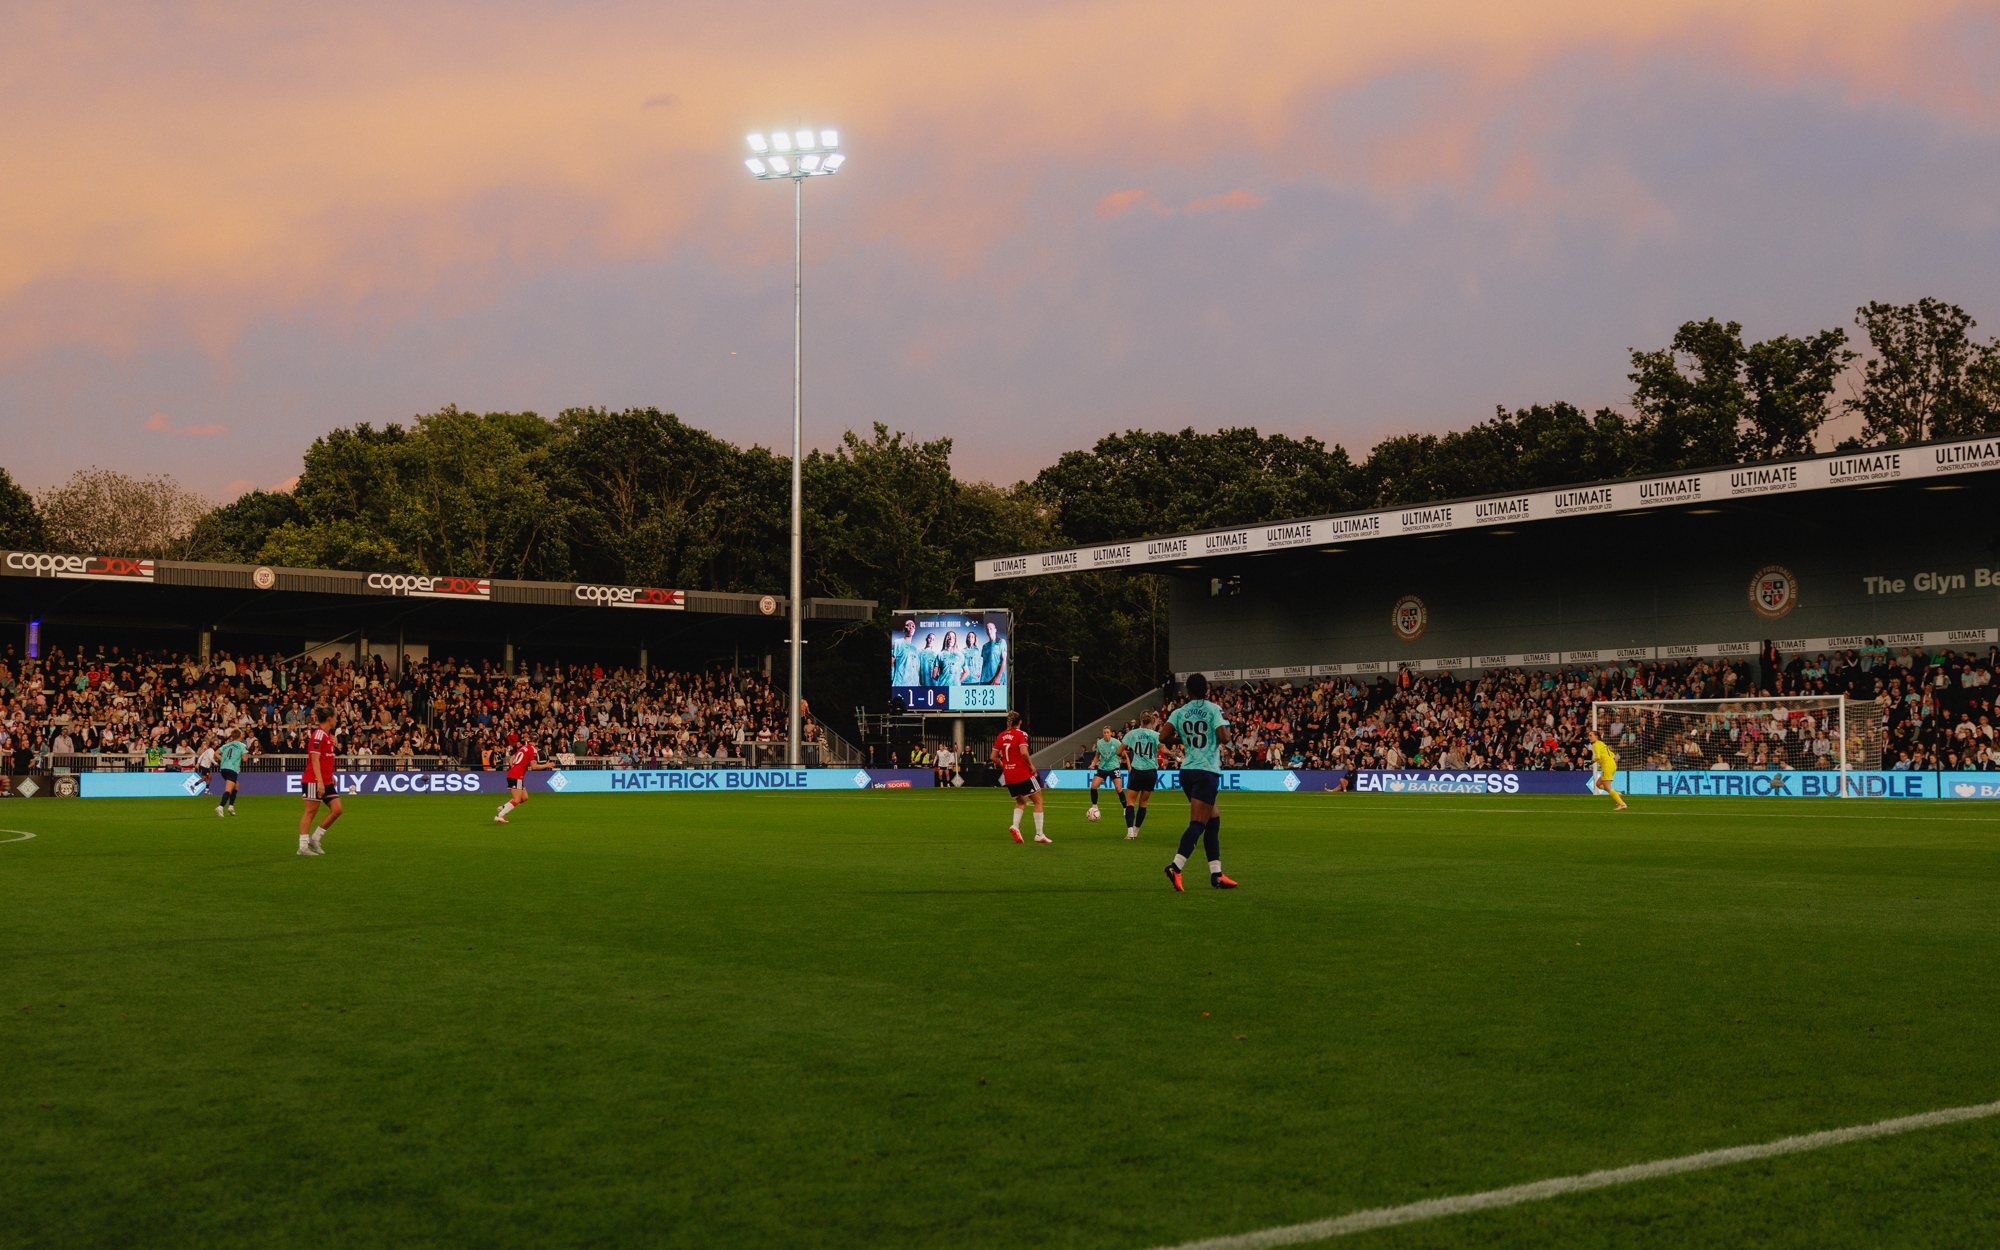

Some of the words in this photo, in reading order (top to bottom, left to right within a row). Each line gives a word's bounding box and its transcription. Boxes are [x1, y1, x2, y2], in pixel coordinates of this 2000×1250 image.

[1829, 454, 1899, 476] ULTIMATE
[1936, 461, 1979, 472] CONSTRUCTION
[1730, 466, 1796, 487] ULTIMATE
[1829, 474, 1869, 484] CONSTRUCTION
[1639, 477, 1700, 498] ULTIMATE
[1731, 485, 1768, 494] CONSTRUCTION
[1554, 488, 1611, 507] ULTIMATE
[1640, 496, 1674, 505] CONSTRUCTION
[1475, 498, 1528, 517] ULTIMATE
[1554, 505, 1587, 514] CONSTRUCTION
[1401, 507, 1451, 525] ULTIMATE
[1476, 515, 1506, 523] CONSTRUCTION
[1332, 516, 1379, 533] ULTIMATE
[1402, 524, 1430, 532] CONSTRUCTION
[1267, 524, 1311, 541] ULTIMATE
[1147, 539, 1187, 554] ULTIMATE
[1205, 532, 1247, 548] ULTIMATE
[1042, 552, 1077, 566] ULTIMATE
[1093, 546, 1130, 560] ULTIMATE
[993, 558, 1026, 572] ULTIMATE
[1863, 576, 1906, 594] The
[1914, 572, 1966, 594] Glyn
[1828, 636, 1862, 646] ULTIMATE
[1887, 633, 1924, 643] ULTIMATE
[1948, 630, 1986, 640] ULTIMATE
[1616, 648, 1646, 656] ULTIMATE
[1667, 645, 1697, 654] ULTIMATE
[1717, 642, 1749, 652] ULTIMATE
[1523, 653, 1550, 661] ULTIMATE
[1569, 651, 1598, 659] ULTIMATE
[965, 689, 995, 706] 35:23
[1003, 743, 1011, 762] 7
[374, 774, 480, 792] ACCESS
[612, 773, 719, 789] HAT-TRICK
[726, 772, 807, 788] BUNDLE
[1408, 782, 1482, 793] BARCLAYS
[1657, 775, 1792, 795] HAT-TRICK
[1802, 776, 1923, 797] BUNDLE
